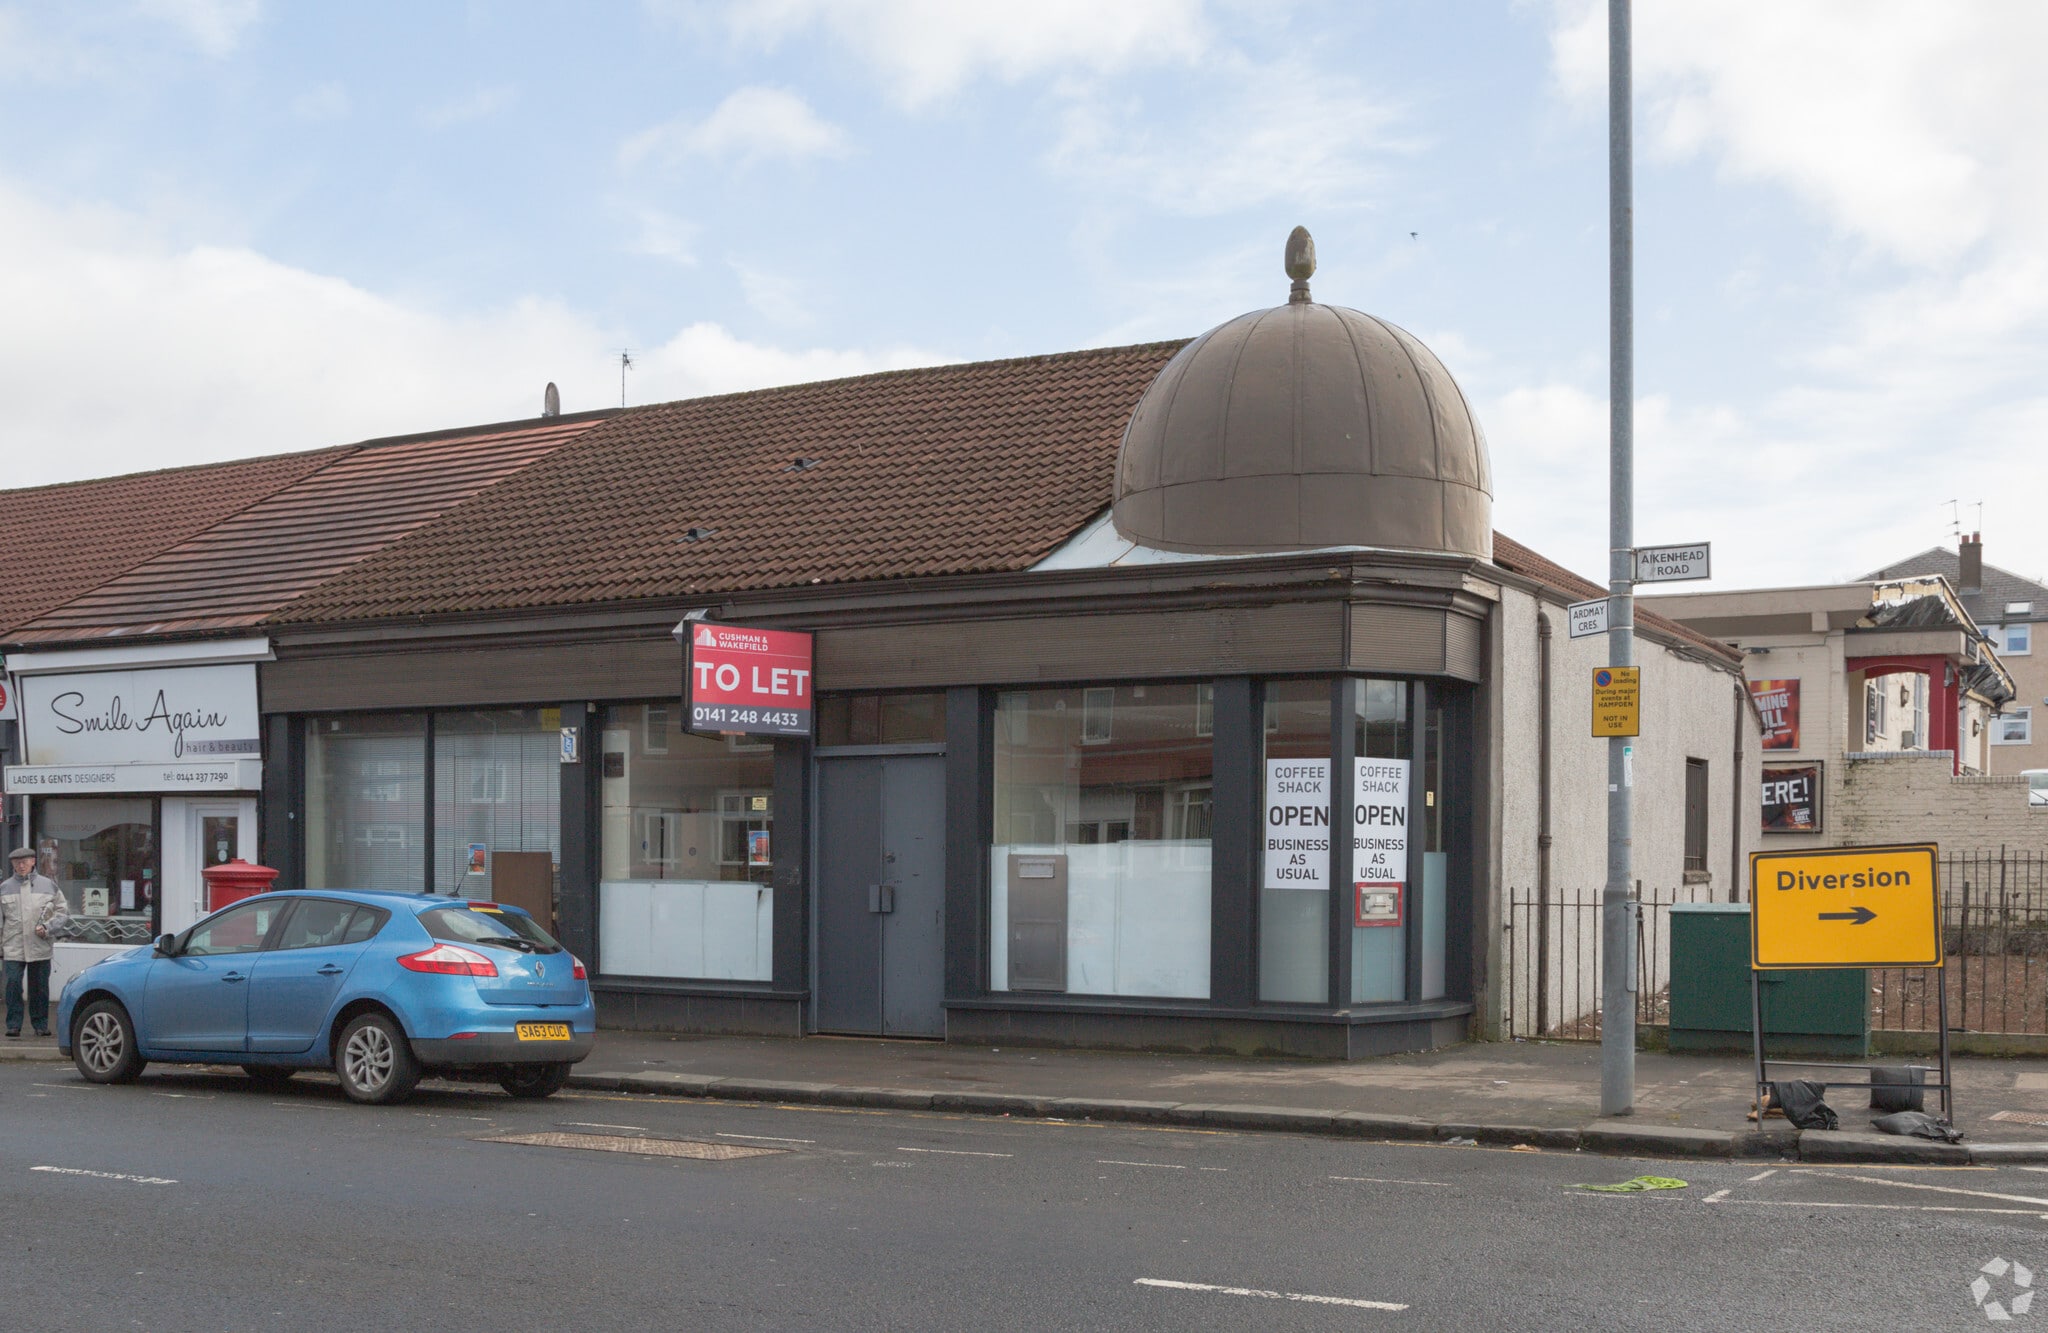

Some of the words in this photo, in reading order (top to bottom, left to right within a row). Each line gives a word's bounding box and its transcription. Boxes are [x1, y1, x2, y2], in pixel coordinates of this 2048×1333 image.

[1641, 551, 1704, 564] AIKENHEAD
[1657, 565, 1689, 576] ROAD
[1573, 606, 1604, 620] ARDMAY
[719, 633, 760, 643] CUSHMAN
[762, 636, 768, 644] &
[719, 641, 768, 651] WAKEFIELD
[694, 662, 740, 692] TO
[752, 666, 809, 696] LET
[1618, 688, 1637, 696] major
[693, 707, 726, 722] 0141
[729, 709, 758, 723] 248
[762, 712, 798, 726] 4433
[51, 691, 134, 734] Smile
[136, 689, 227, 758] Again
[186, 742, 206, 752] hair
[209, 742, 217, 751] &
[218, 742, 254, 752] beauty
[13, 775, 38, 784] LADIES
[41, 775, 46, 784] &
[48, 774, 72, 784] GENTS
[75, 773, 116, 783] DESIGNERS
[176, 773, 194, 783] 0141
[196, 773, 208, 783] 237
[210, 772, 228, 782] 7290
[1275, 767, 1325, 778] COFFEE
[1360, 766, 1402, 779] COFFEE
[1278, 782, 1321, 793] SHACK
[1362, 781, 1399, 793] SHACK
[1761, 777, 1809, 805] ERE!
[1269, 806, 1329, 826] OPEN
[1355, 805, 1405, 826] OPEN
[1268, 839, 1329, 850] BUSINESS
[1353, 838, 1404, 850] BUSINESS
[1289, 854, 1306, 865] AS
[1371, 853, 1385, 864] AS
[1276, 869, 1319, 880] USUAL
[1360, 867, 1396, 879] USUAL
[1777, 867, 1911, 891] Diversion
[520, 1025, 546, 1037] SA63
[547, 1025, 566, 1037] CUC
